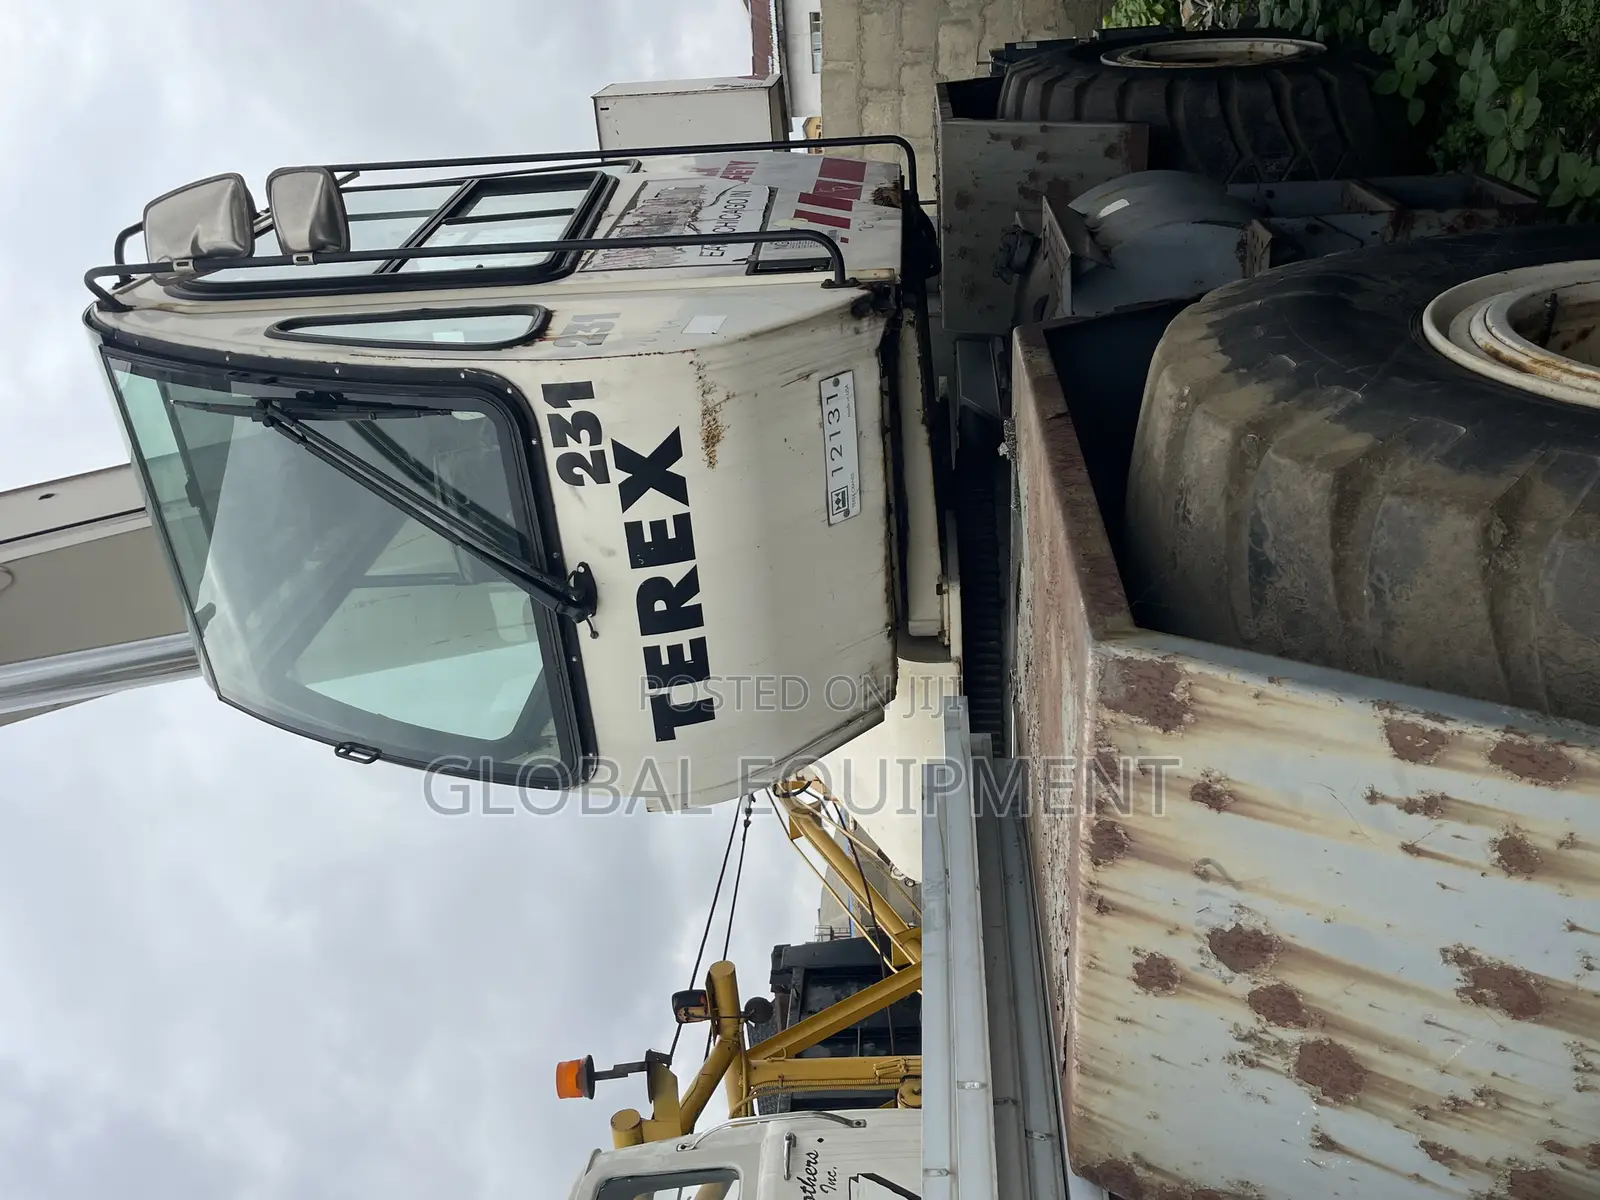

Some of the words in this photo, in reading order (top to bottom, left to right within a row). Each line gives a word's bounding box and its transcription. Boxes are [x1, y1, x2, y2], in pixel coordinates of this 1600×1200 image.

[729, 190, 753, 198] IN
[712, 199, 749, 232] CHICAGO
[553, 312, 621, 347] 231
[541, 380, 611, 487] 231
[826, 393, 844, 477] 12131
[611, 425, 716, 742] TEREX
[819, 1166, 837, 1194] Inc.
